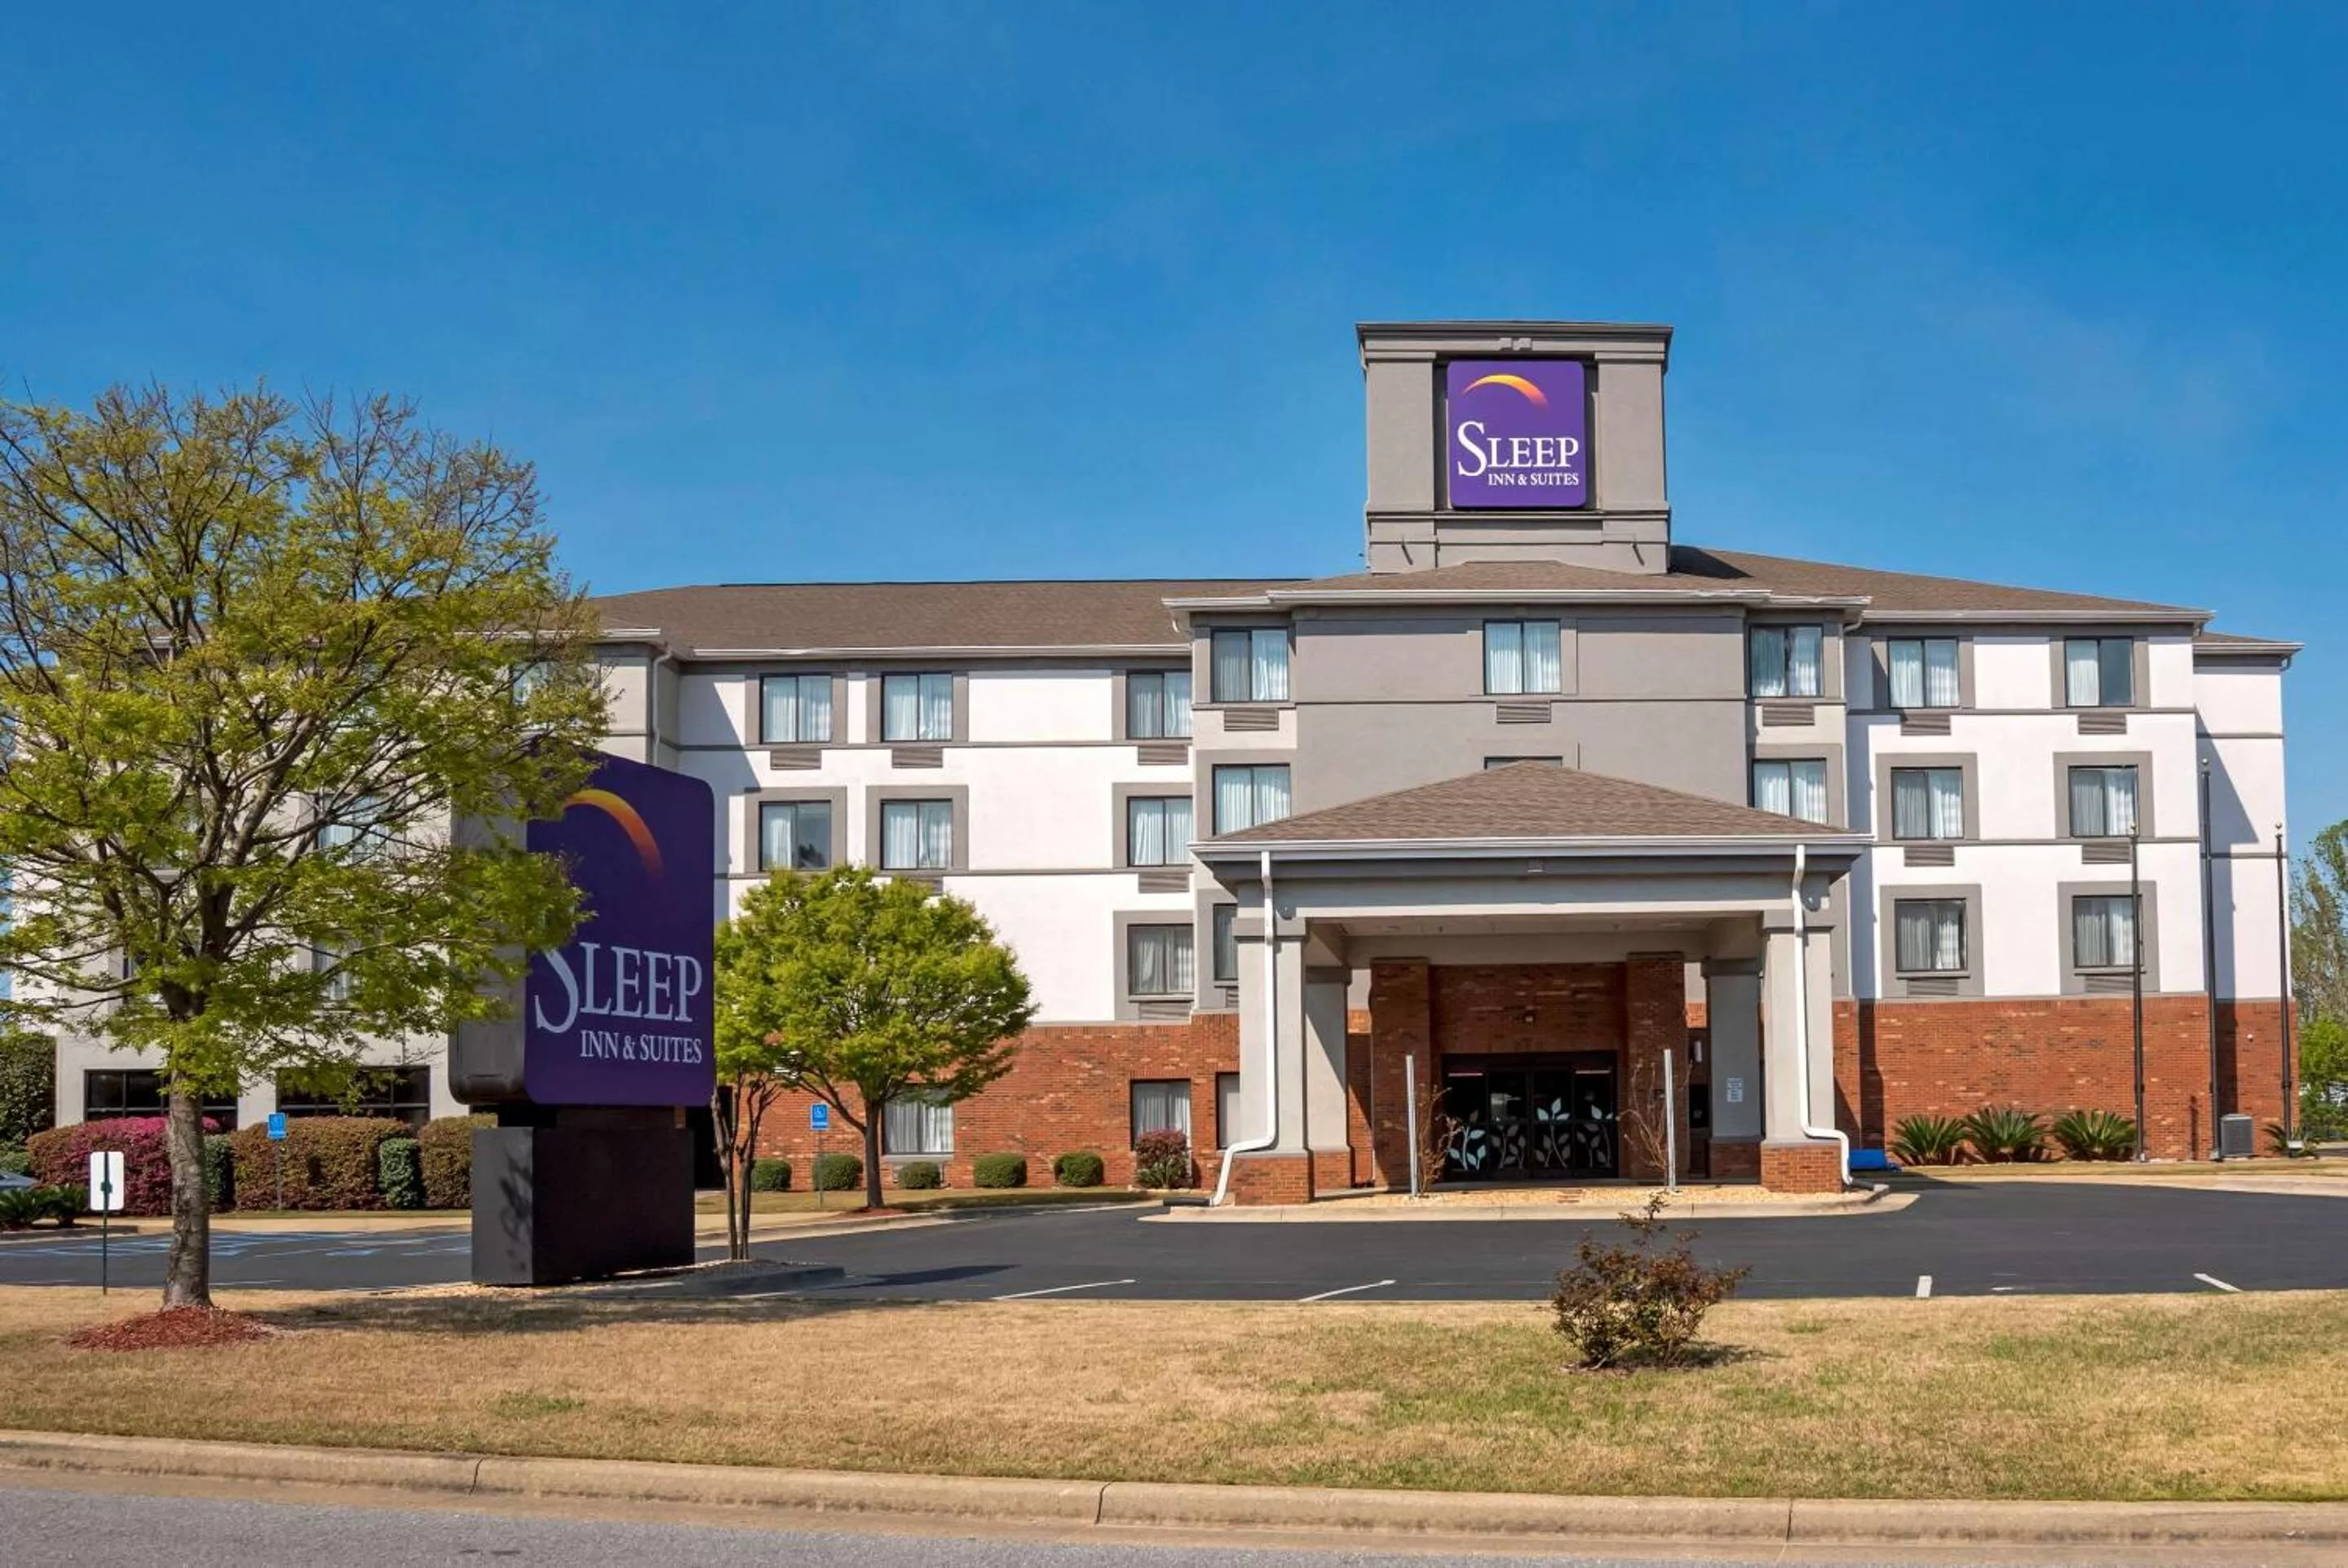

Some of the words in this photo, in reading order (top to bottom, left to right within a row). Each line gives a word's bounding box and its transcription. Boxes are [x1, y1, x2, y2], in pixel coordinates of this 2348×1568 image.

[1457, 420, 1579, 477] SLEEP
[1488, 473, 1515, 486] INN
[1518, 473, 1528, 486] &
[1530, 472, 1580, 486] SUITES
[580, 1030, 620, 1059] INN
[622, 1035, 636, 1061] &
[639, 1034, 702, 1064] SUITES
